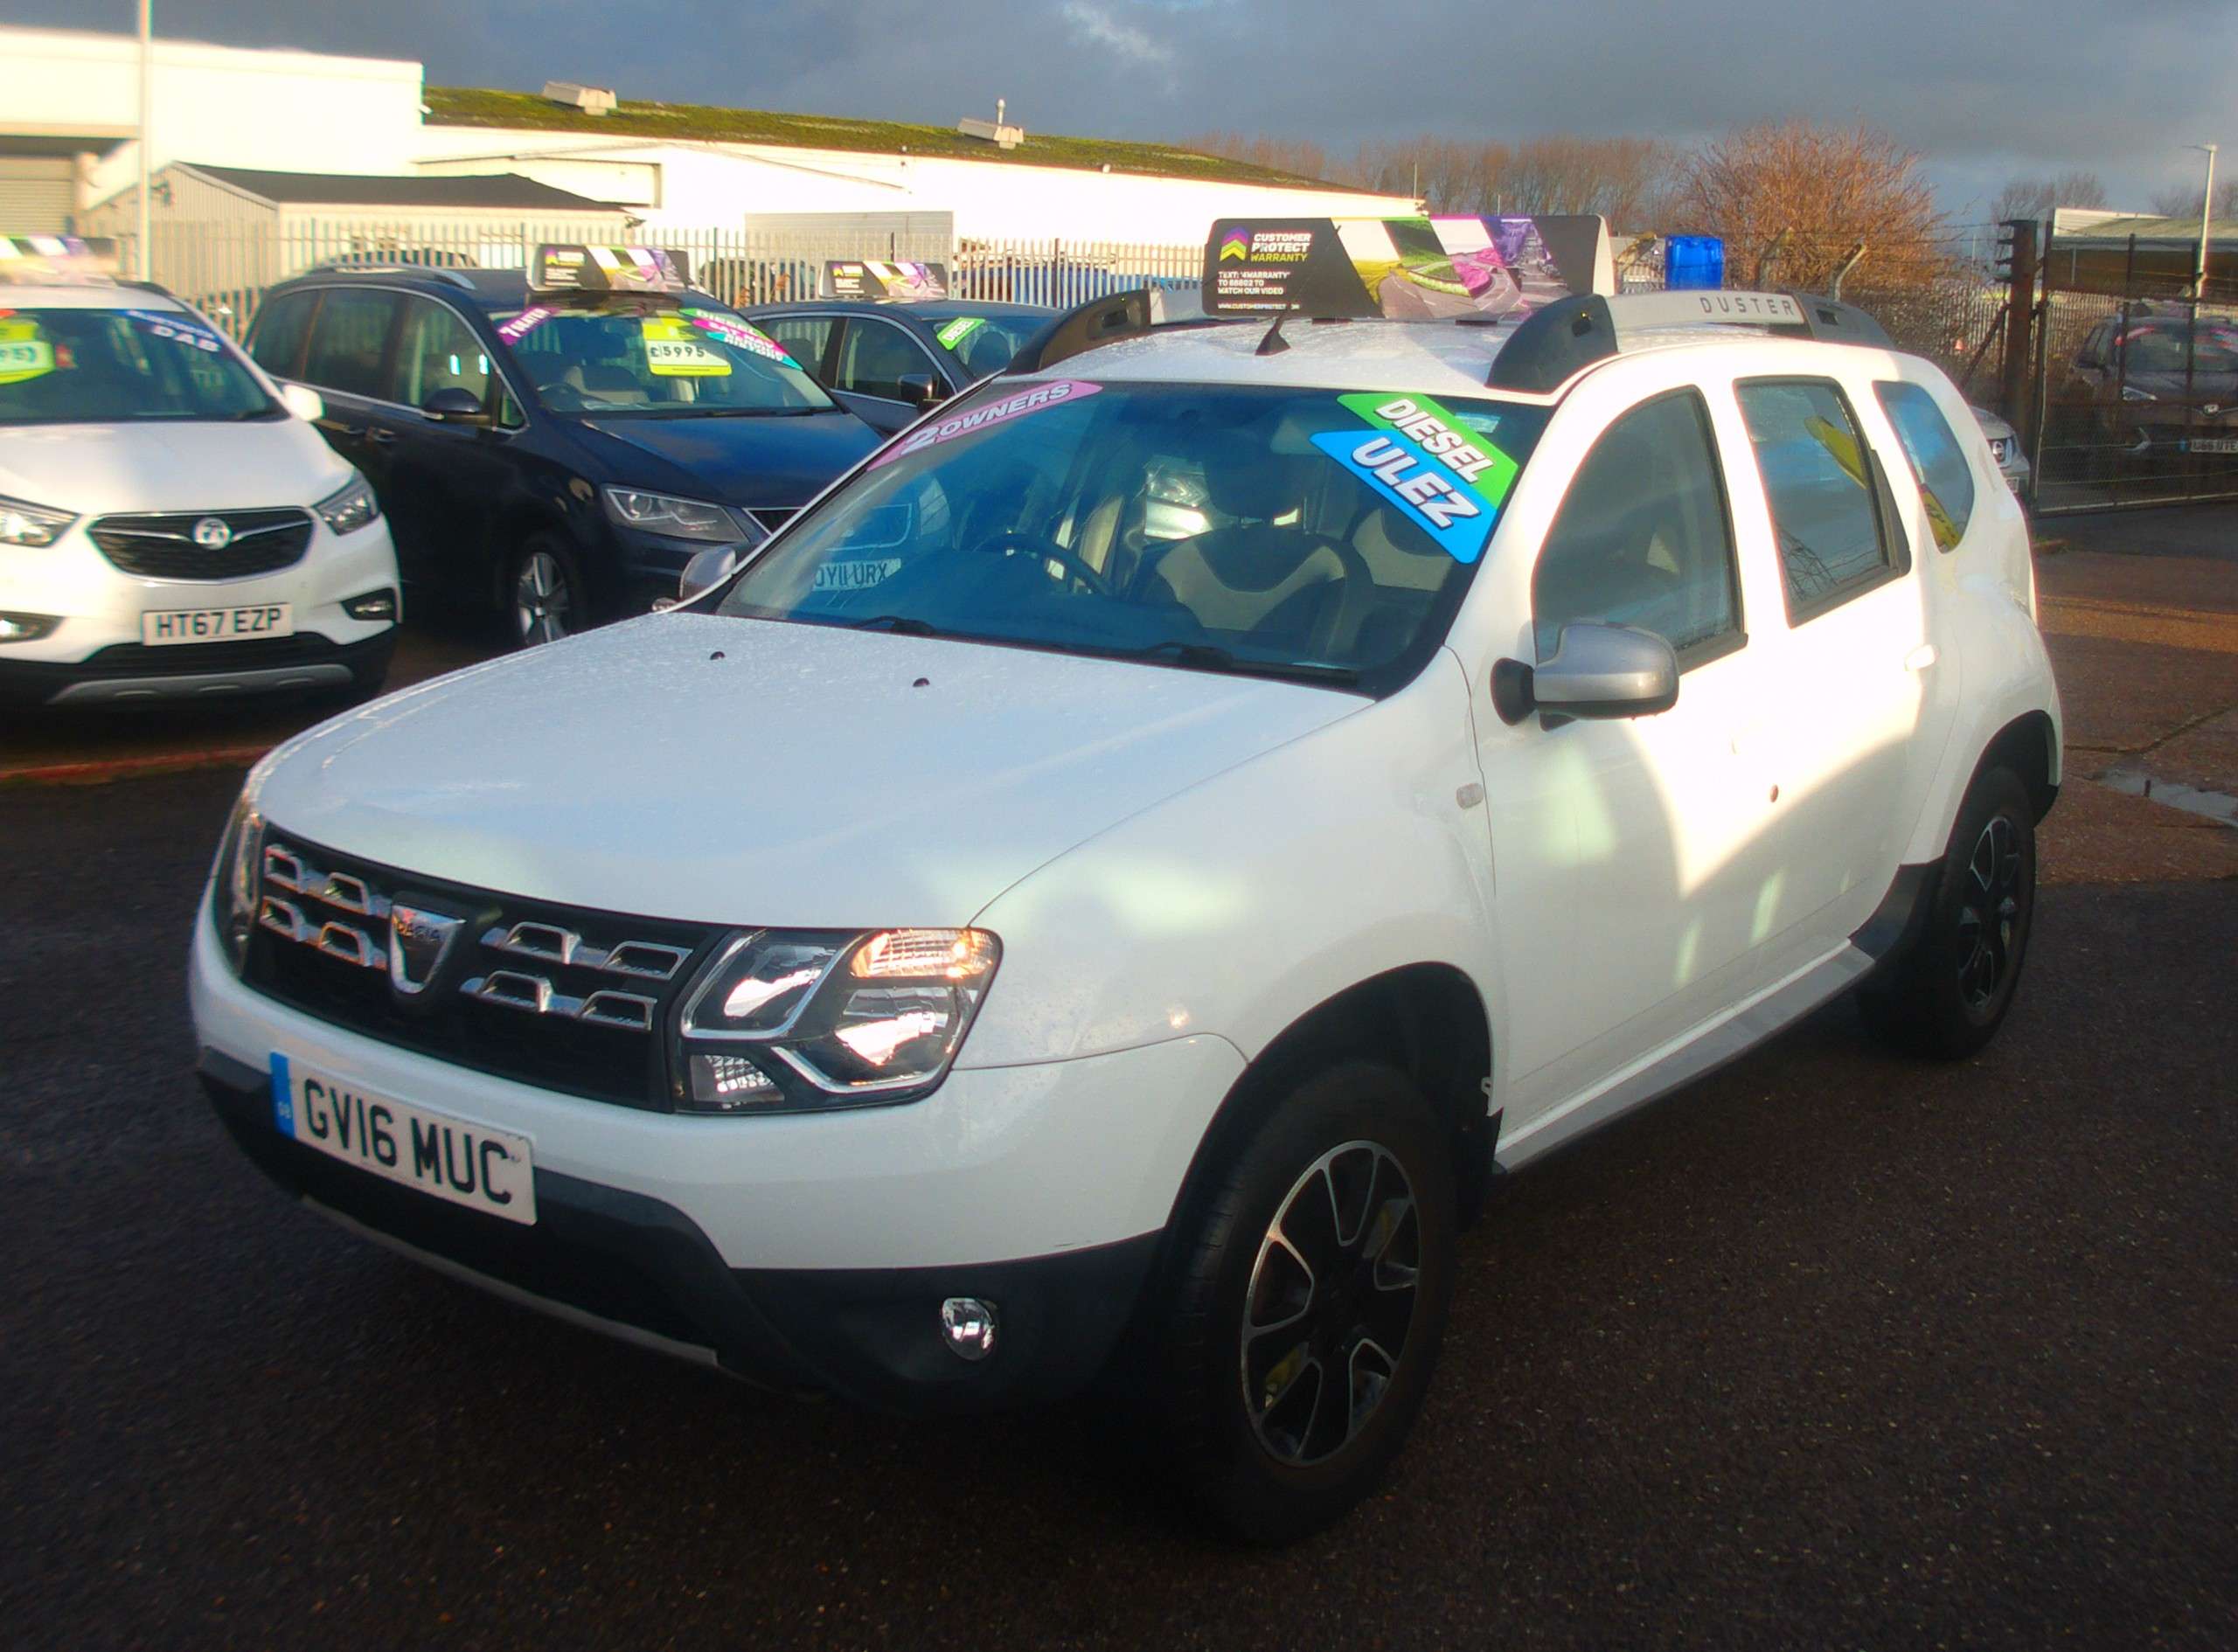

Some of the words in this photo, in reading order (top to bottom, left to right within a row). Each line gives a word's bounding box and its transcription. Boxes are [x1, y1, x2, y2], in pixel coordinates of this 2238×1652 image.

[1251, 242, 1310, 253] PROTECT
[1254, 233, 1311, 242] CUSTOMER
[1250, 253, 1308, 262] WARRANTY
[1699, 296, 1795, 316] DUSTER
[900, 425, 941, 455] 2
[939, 383, 1073, 436] OWNERS
[1373, 399, 1494, 483] DIESEL
[1352, 436, 1482, 531] ULEZ
[156, 612, 225, 638] HT67
[233, 607, 281, 633] EZP
[303, 1077, 398, 1168] GV16
[411, 1116, 512, 1205] MUC
